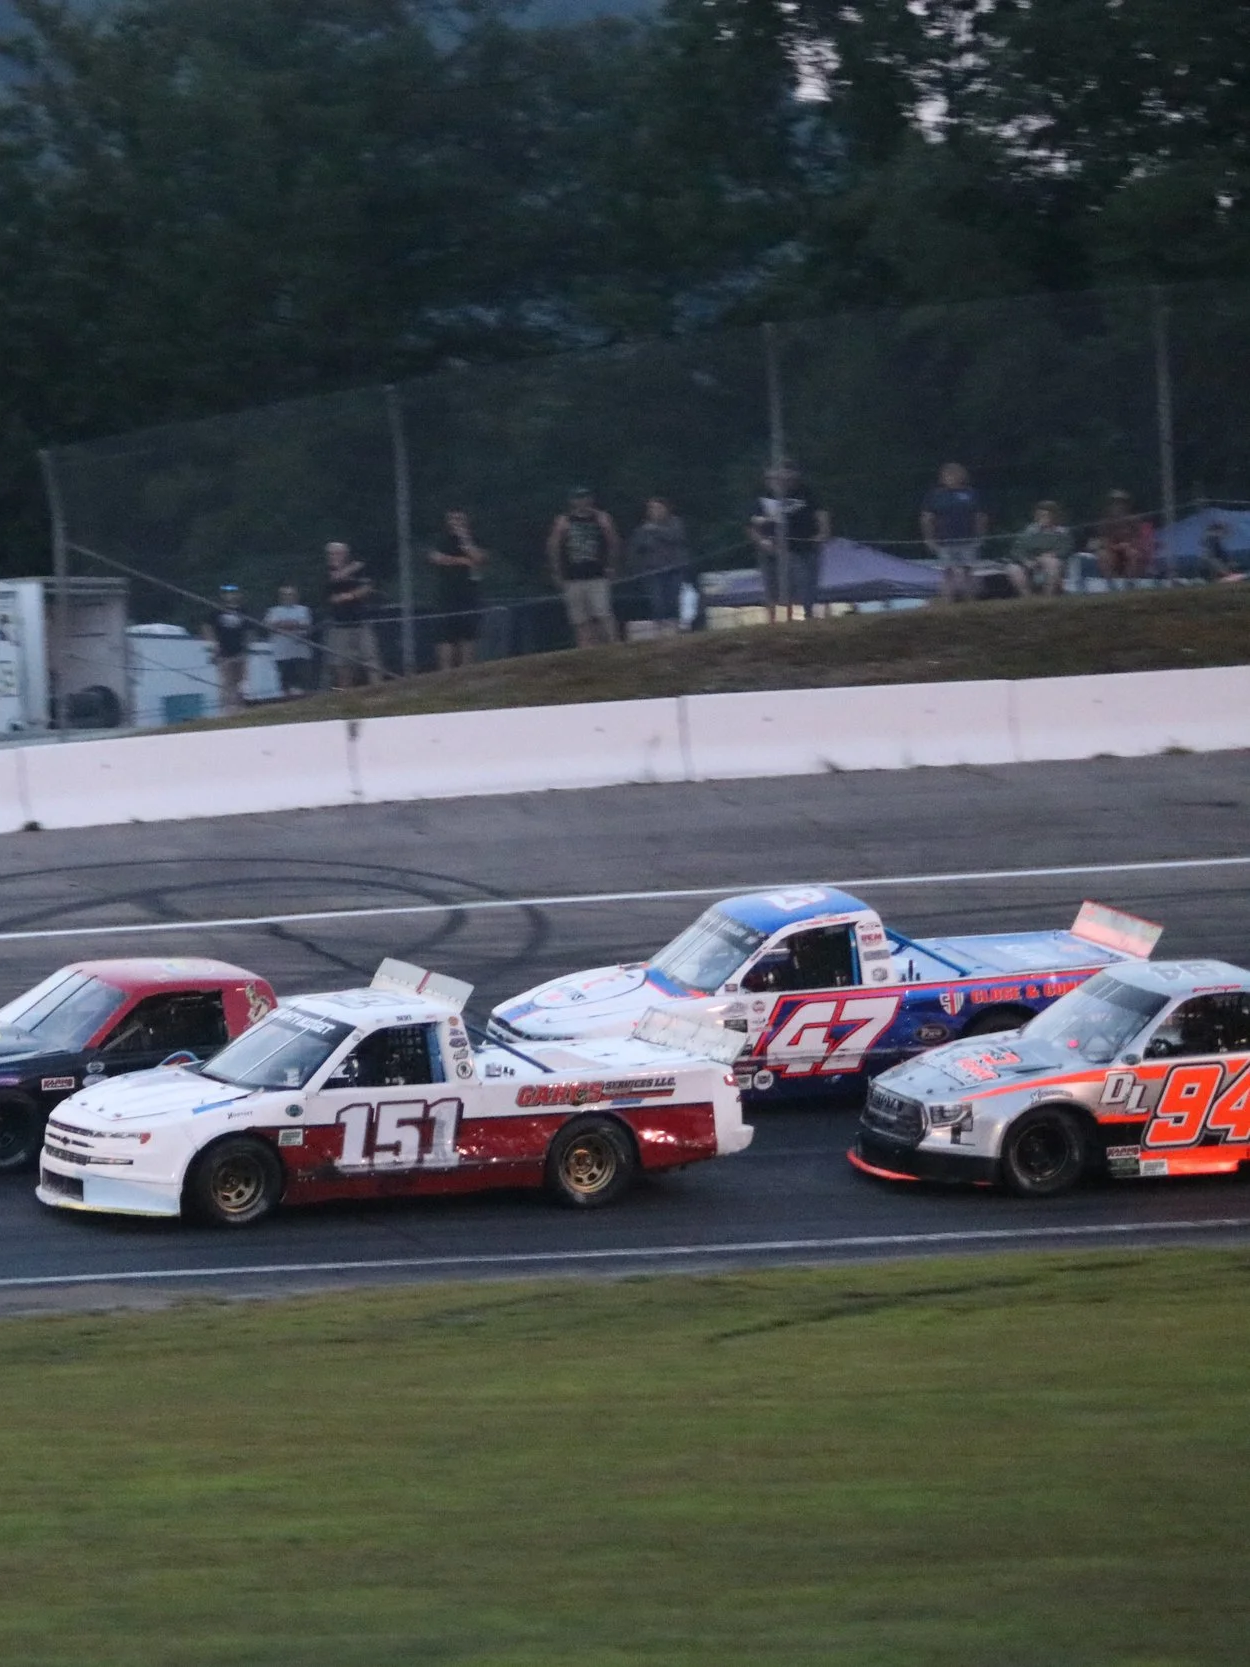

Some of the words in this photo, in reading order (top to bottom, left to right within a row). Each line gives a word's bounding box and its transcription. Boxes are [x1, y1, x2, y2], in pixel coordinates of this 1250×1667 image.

[766, 996, 901, 1077] 47
[605, 1078, 654, 1090] SERVICES
[1143, 1061, 1250, 1150] 94
[334, 1097, 463, 1173] 151
